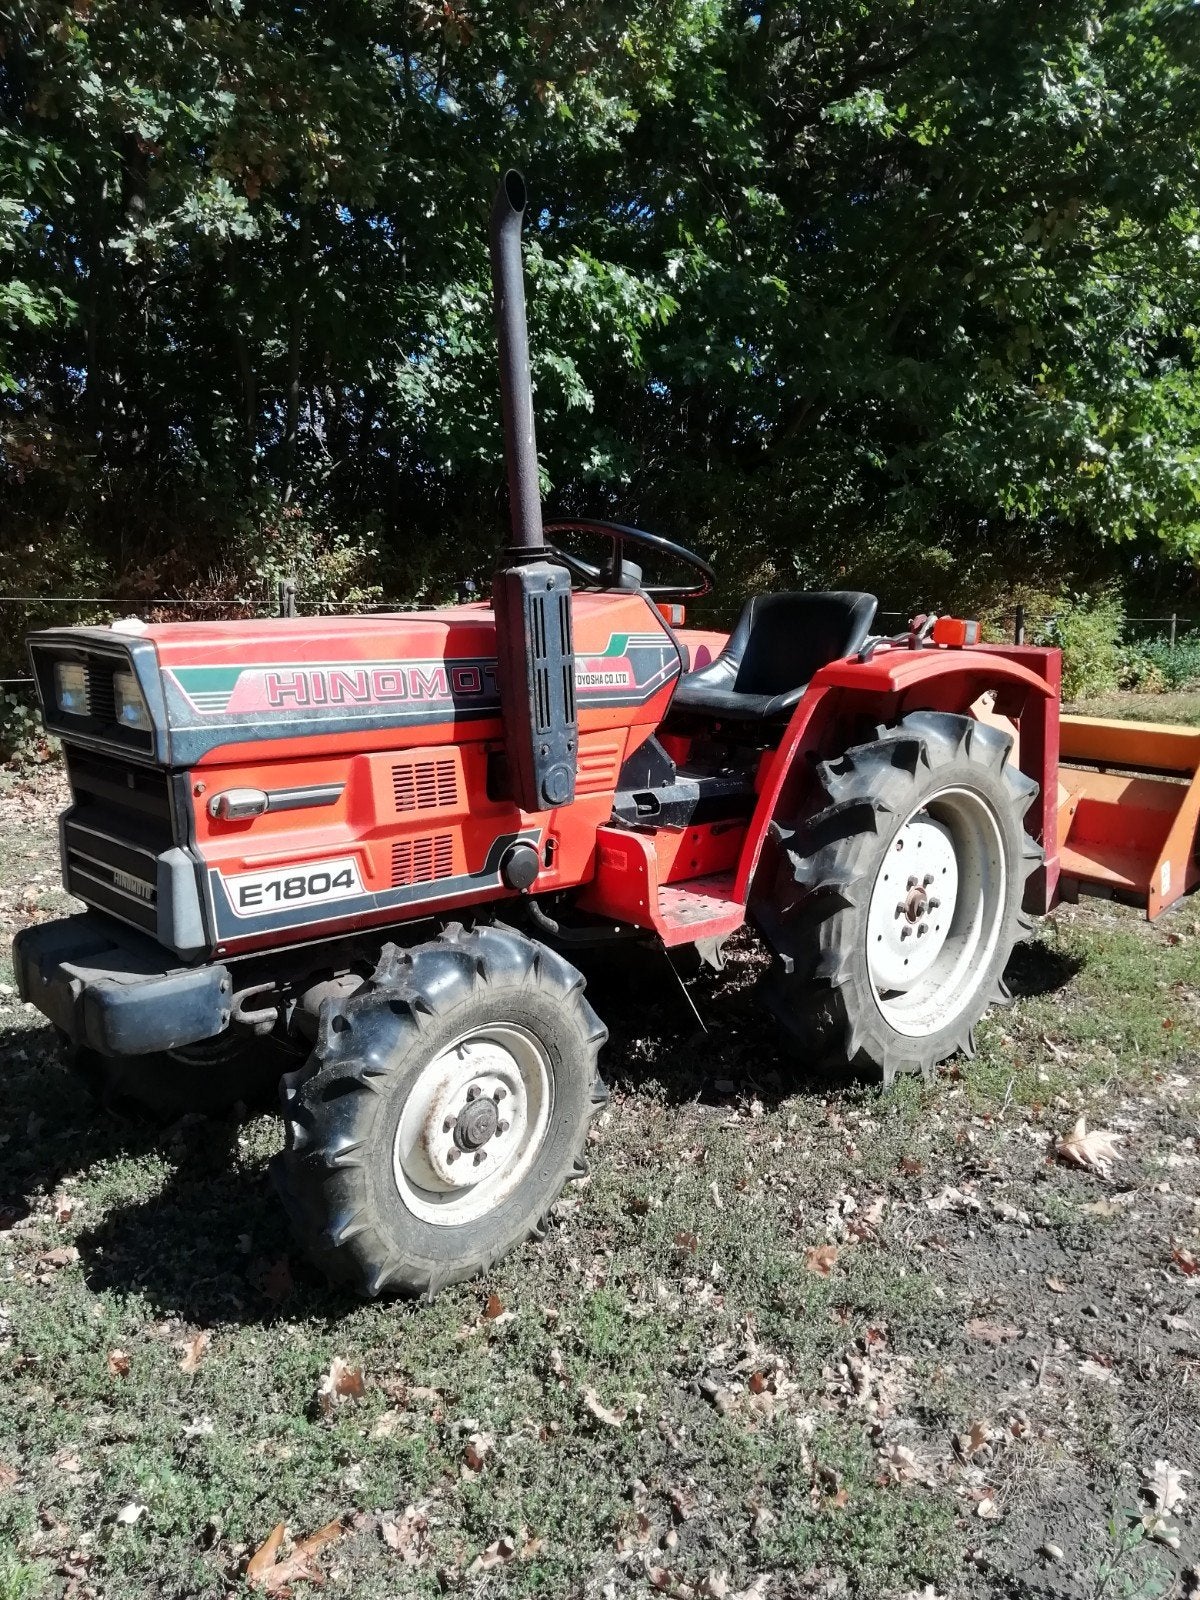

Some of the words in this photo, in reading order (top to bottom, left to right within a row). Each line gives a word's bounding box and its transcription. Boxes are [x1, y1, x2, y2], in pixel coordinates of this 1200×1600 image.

[266, 666, 502, 706] HINOMOT
[574, 674, 603, 685] OYOSHA
[240, 868, 354, 907] E1804
